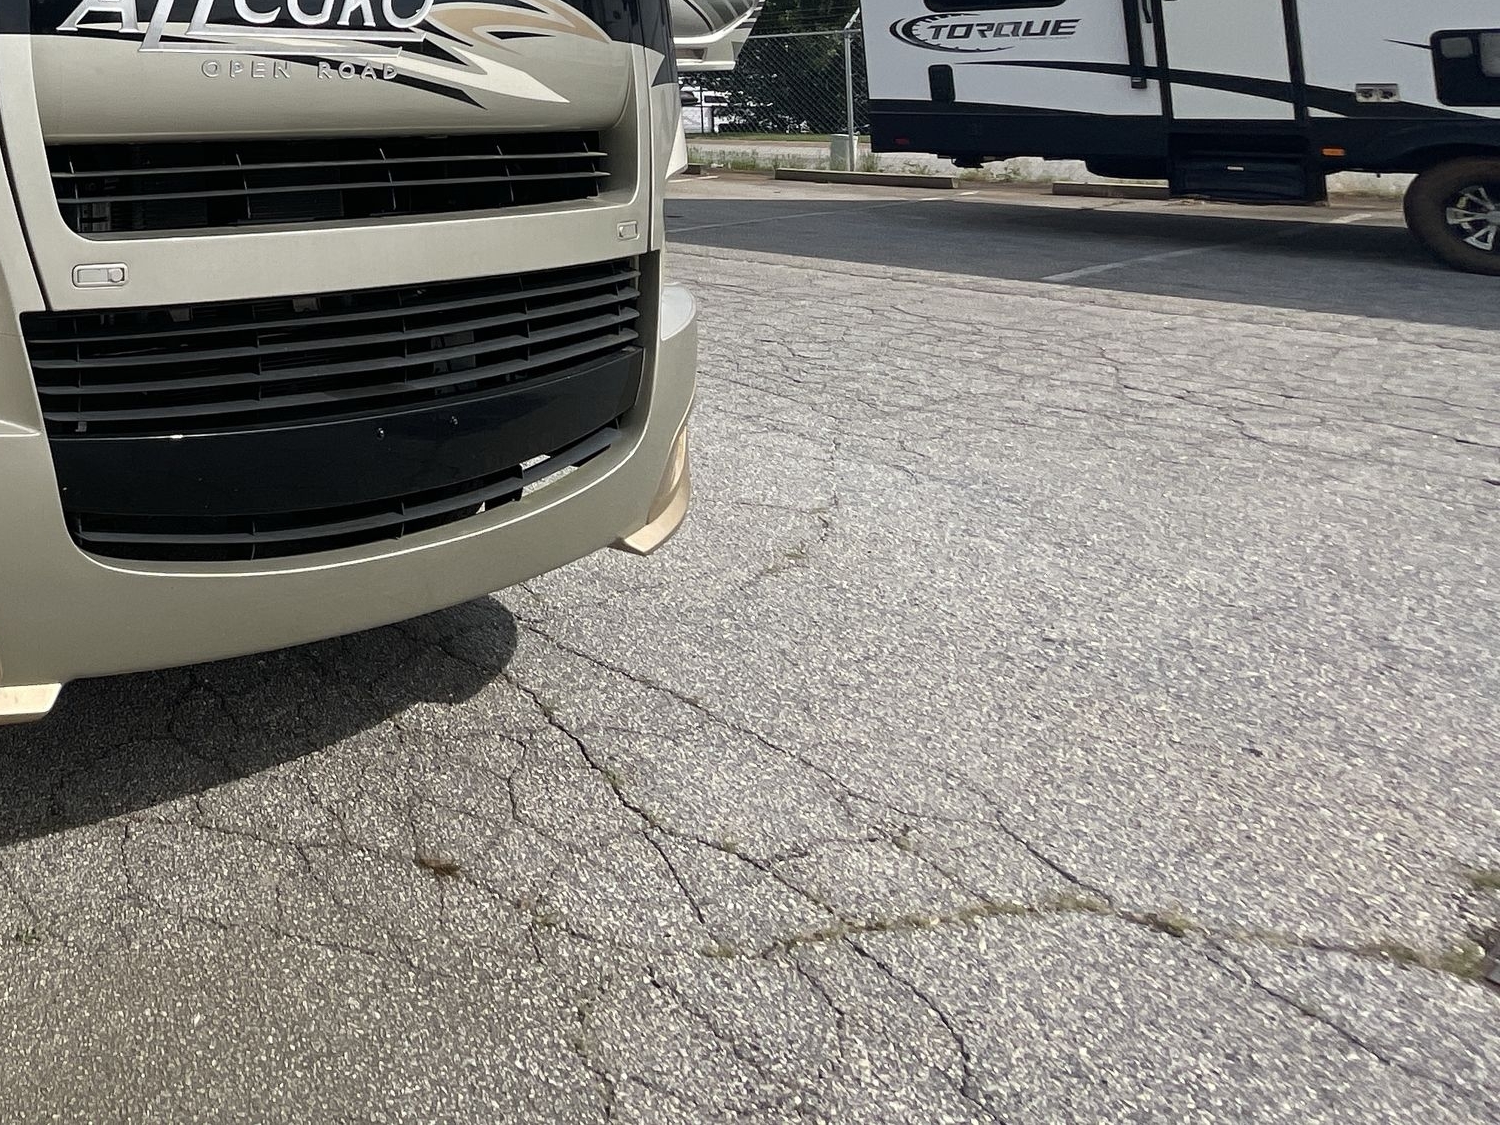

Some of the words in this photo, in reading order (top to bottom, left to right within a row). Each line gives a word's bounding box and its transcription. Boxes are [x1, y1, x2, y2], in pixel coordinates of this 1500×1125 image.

[928, 18, 1081, 39] TORQUE
[202, 59, 291, 79] OPEN
[317, 61, 399, 81] ROAD
